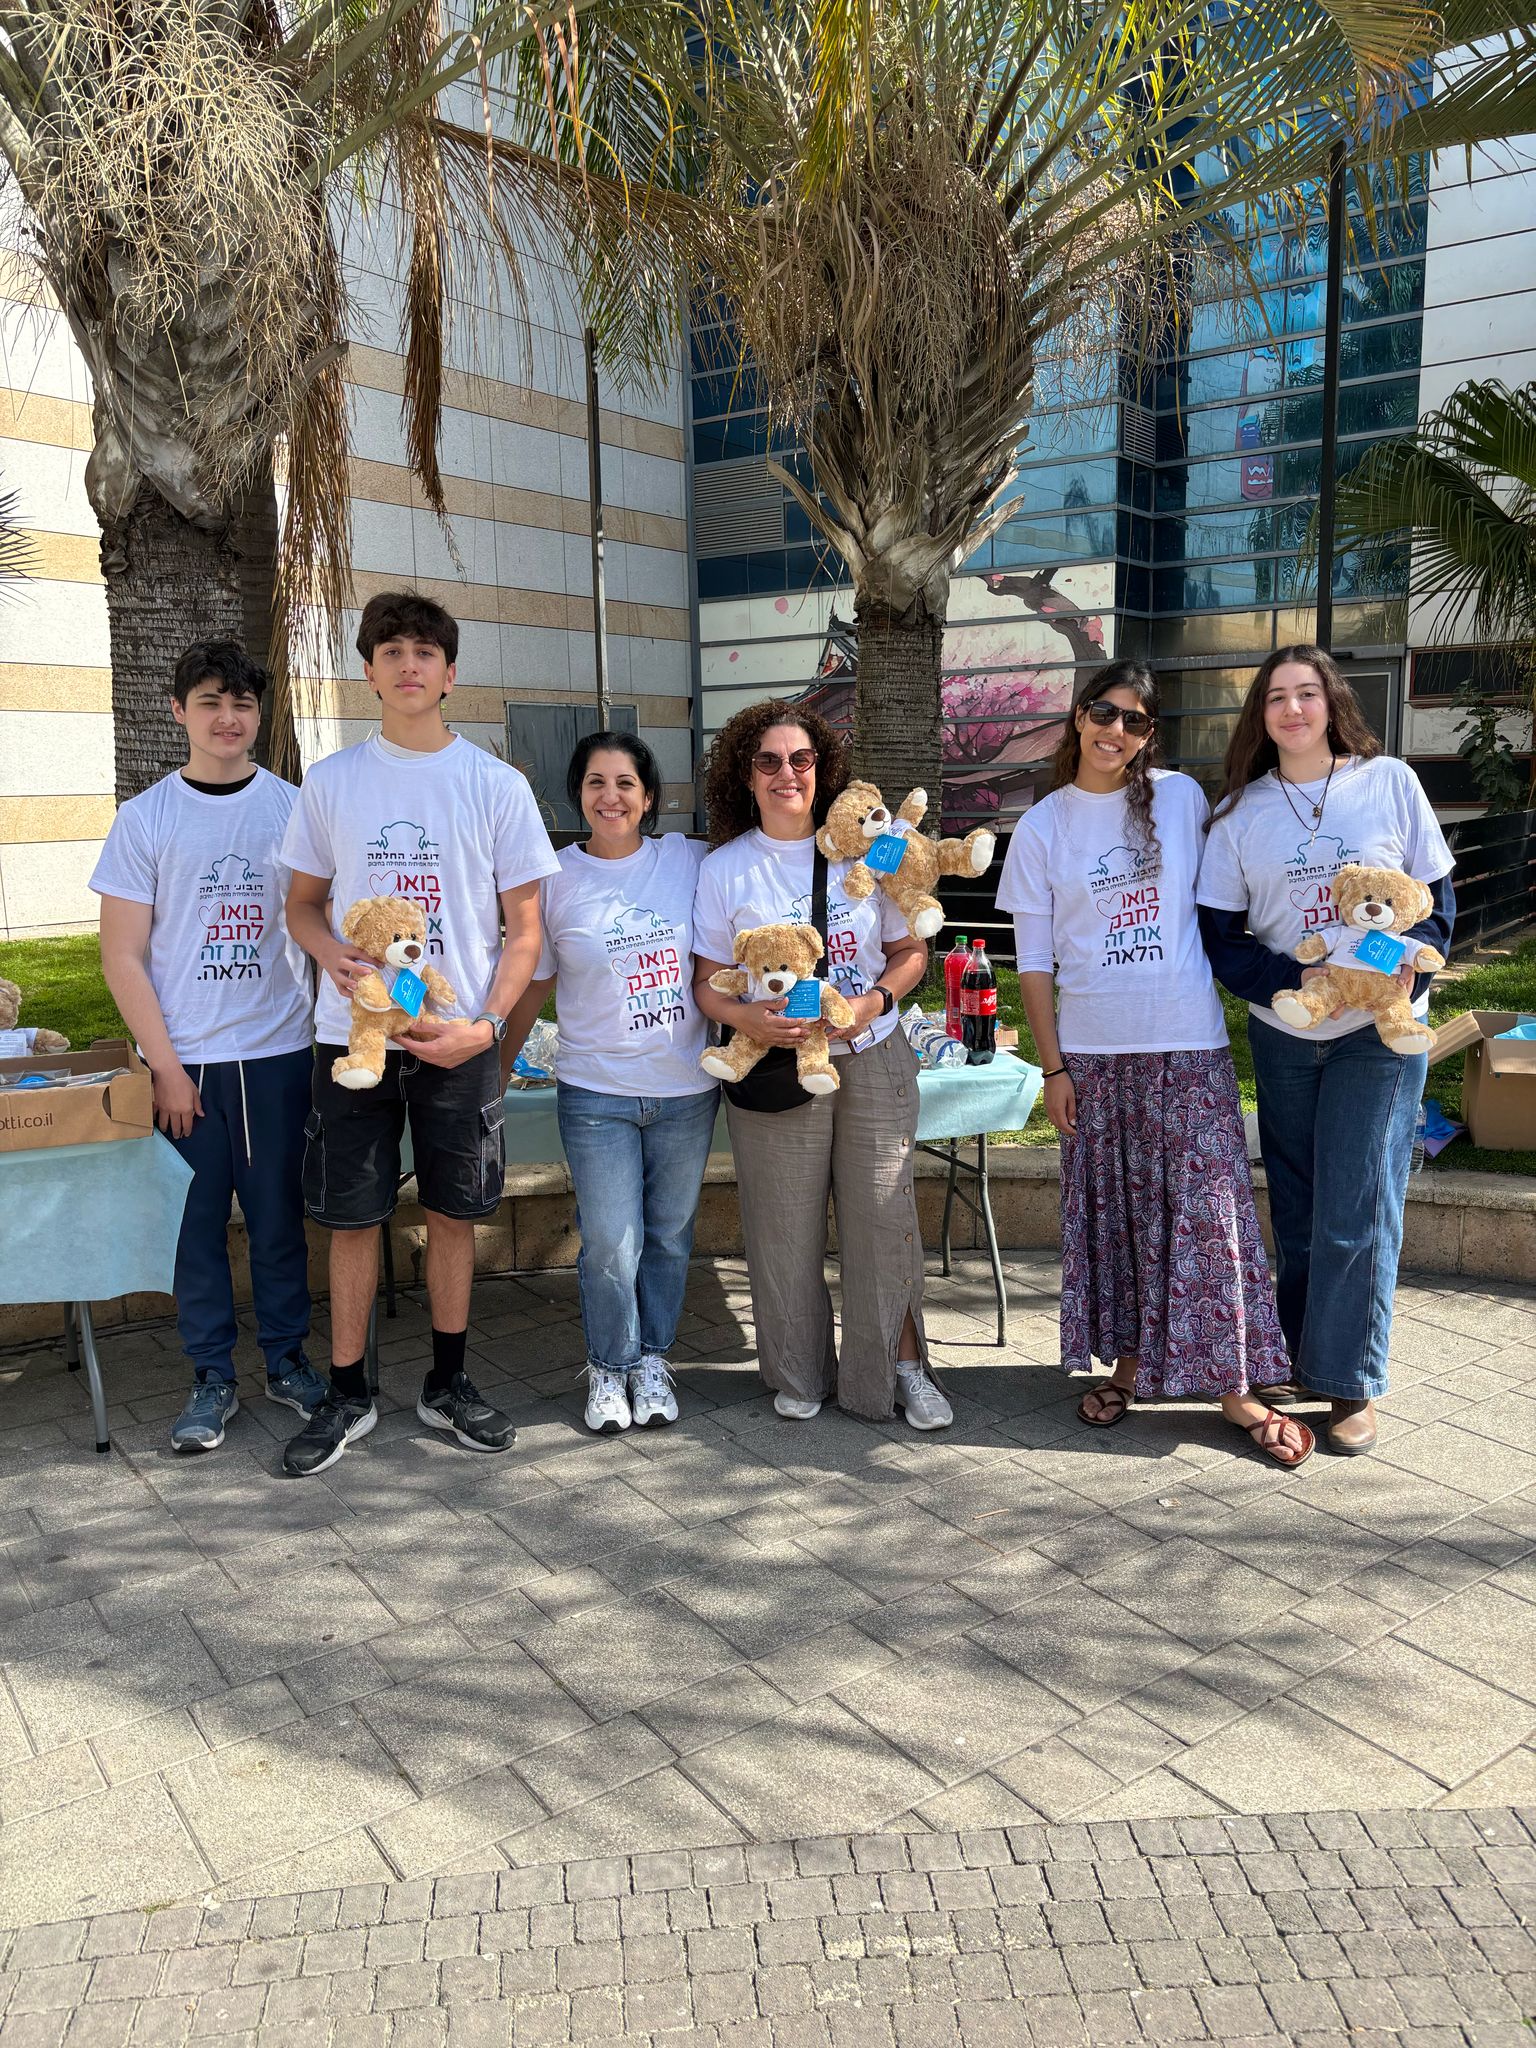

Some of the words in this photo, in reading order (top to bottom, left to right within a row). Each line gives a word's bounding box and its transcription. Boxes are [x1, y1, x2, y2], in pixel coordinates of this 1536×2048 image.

[367, 851, 404, 860] החלמה
[1286, 866, 1325, 877] החלמה
[199, 884, 230, 893] החלמה
[397, 874, 441, 892] בואו
[1091, 874, 1126, 888] החלמה
[401, 893, 441, 913] לח
[1122, 886, 1160, 909] בואו
[222, 904, 264, 920] בואו
[1109, 904, 1160, 933] לחבק
[1303, 905, 1339, 929] בק
[206, 922, 264, 944] לחבק
[605, 934, 642, 947] החלמה
[645, 928, 674, 938] דובוני
[1105, 931, 1126, 948] זה
[1132, 925, 1162, 944] את
[201, 944, 224, 960] זה
[231, 944, 260, 960] את
[638, 948, 678, 969] בואו
[828, 947, 857, 965] לח
[1101, 944, 1163, 967] הלאה.
[197, 962, 262, 980] הלאה.
[627, 965, 680, 995] לחבק
[626, 992, 649, 1011] זה
[656, 986, 684, 1006] את
[629, 1005, 685, 1031] הלאה.
